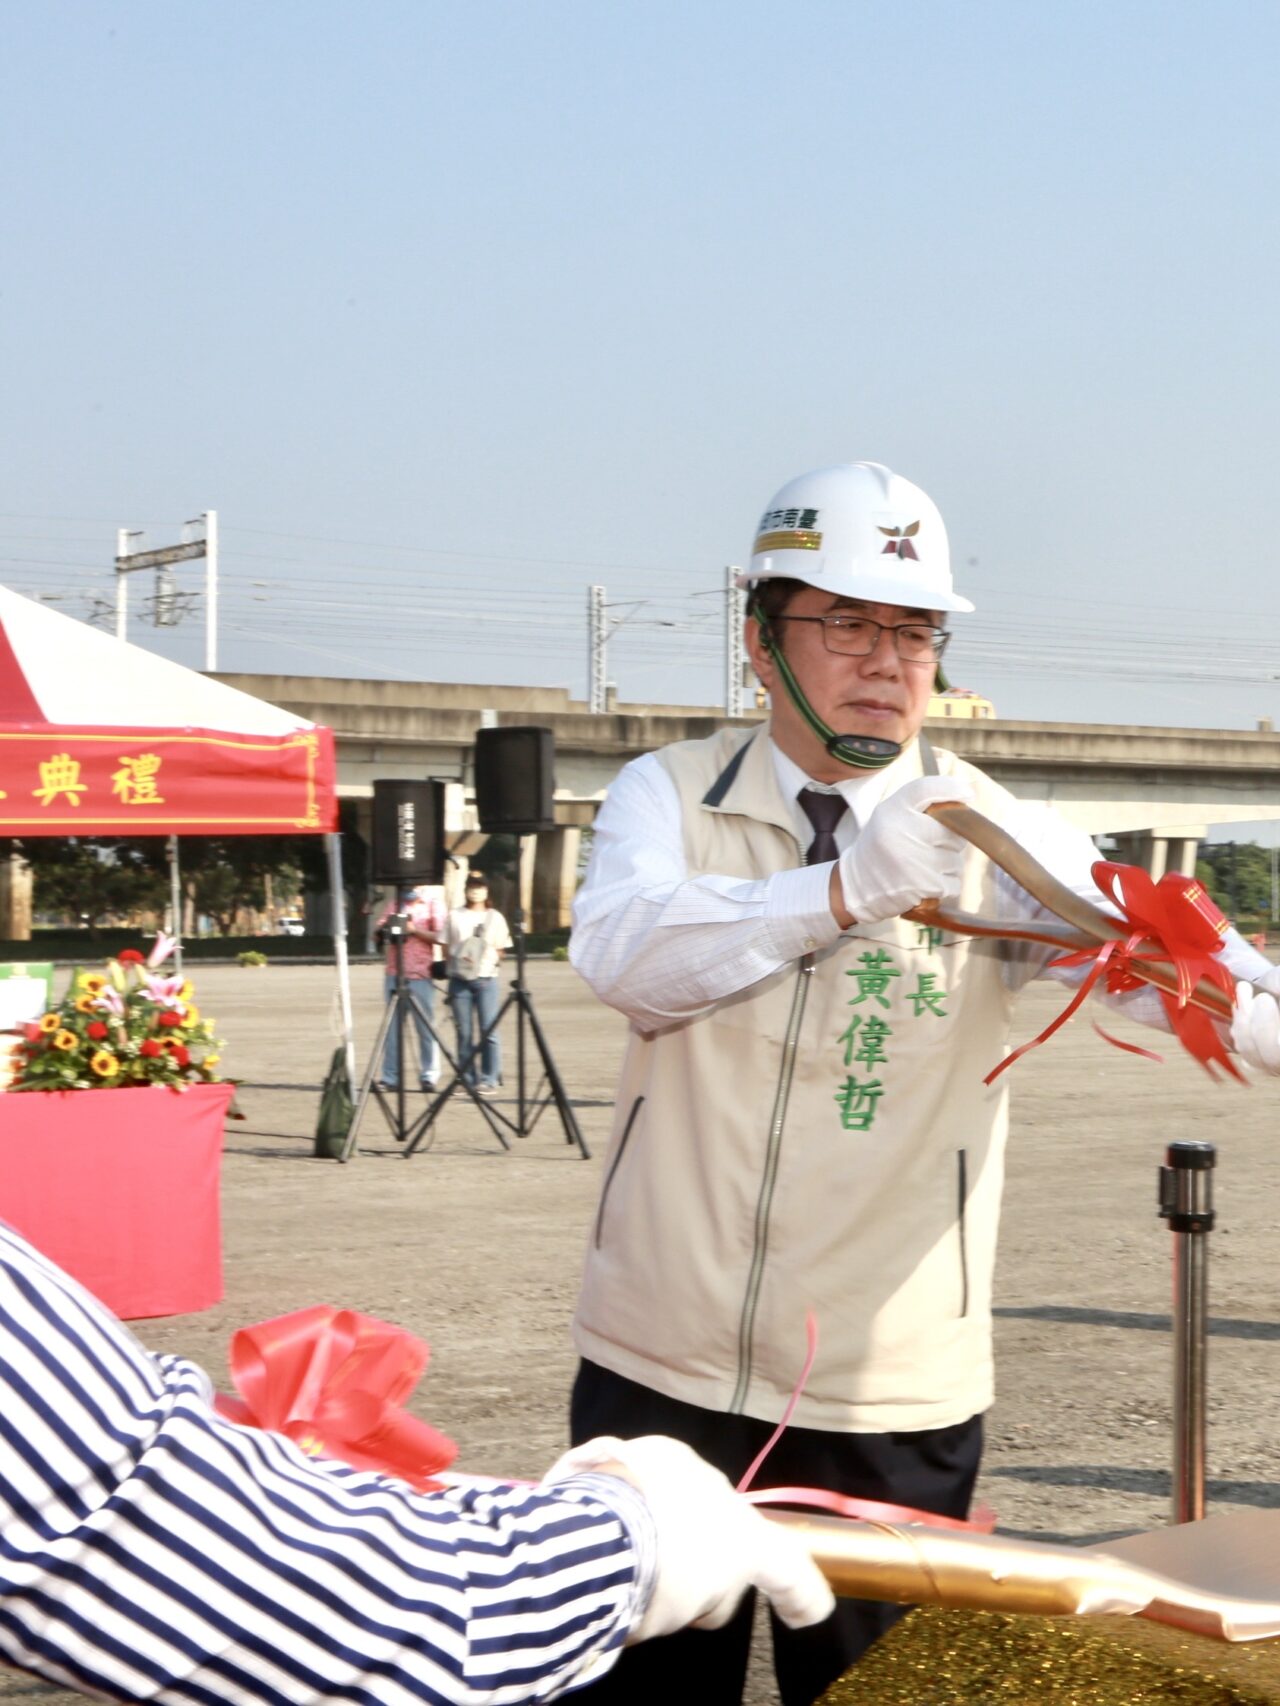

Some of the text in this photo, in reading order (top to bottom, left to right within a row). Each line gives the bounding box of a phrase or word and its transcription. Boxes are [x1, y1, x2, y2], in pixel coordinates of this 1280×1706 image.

[0, 753, 165, 807] 典禮
[834, 949, 901, 1132] 黃偉哲
